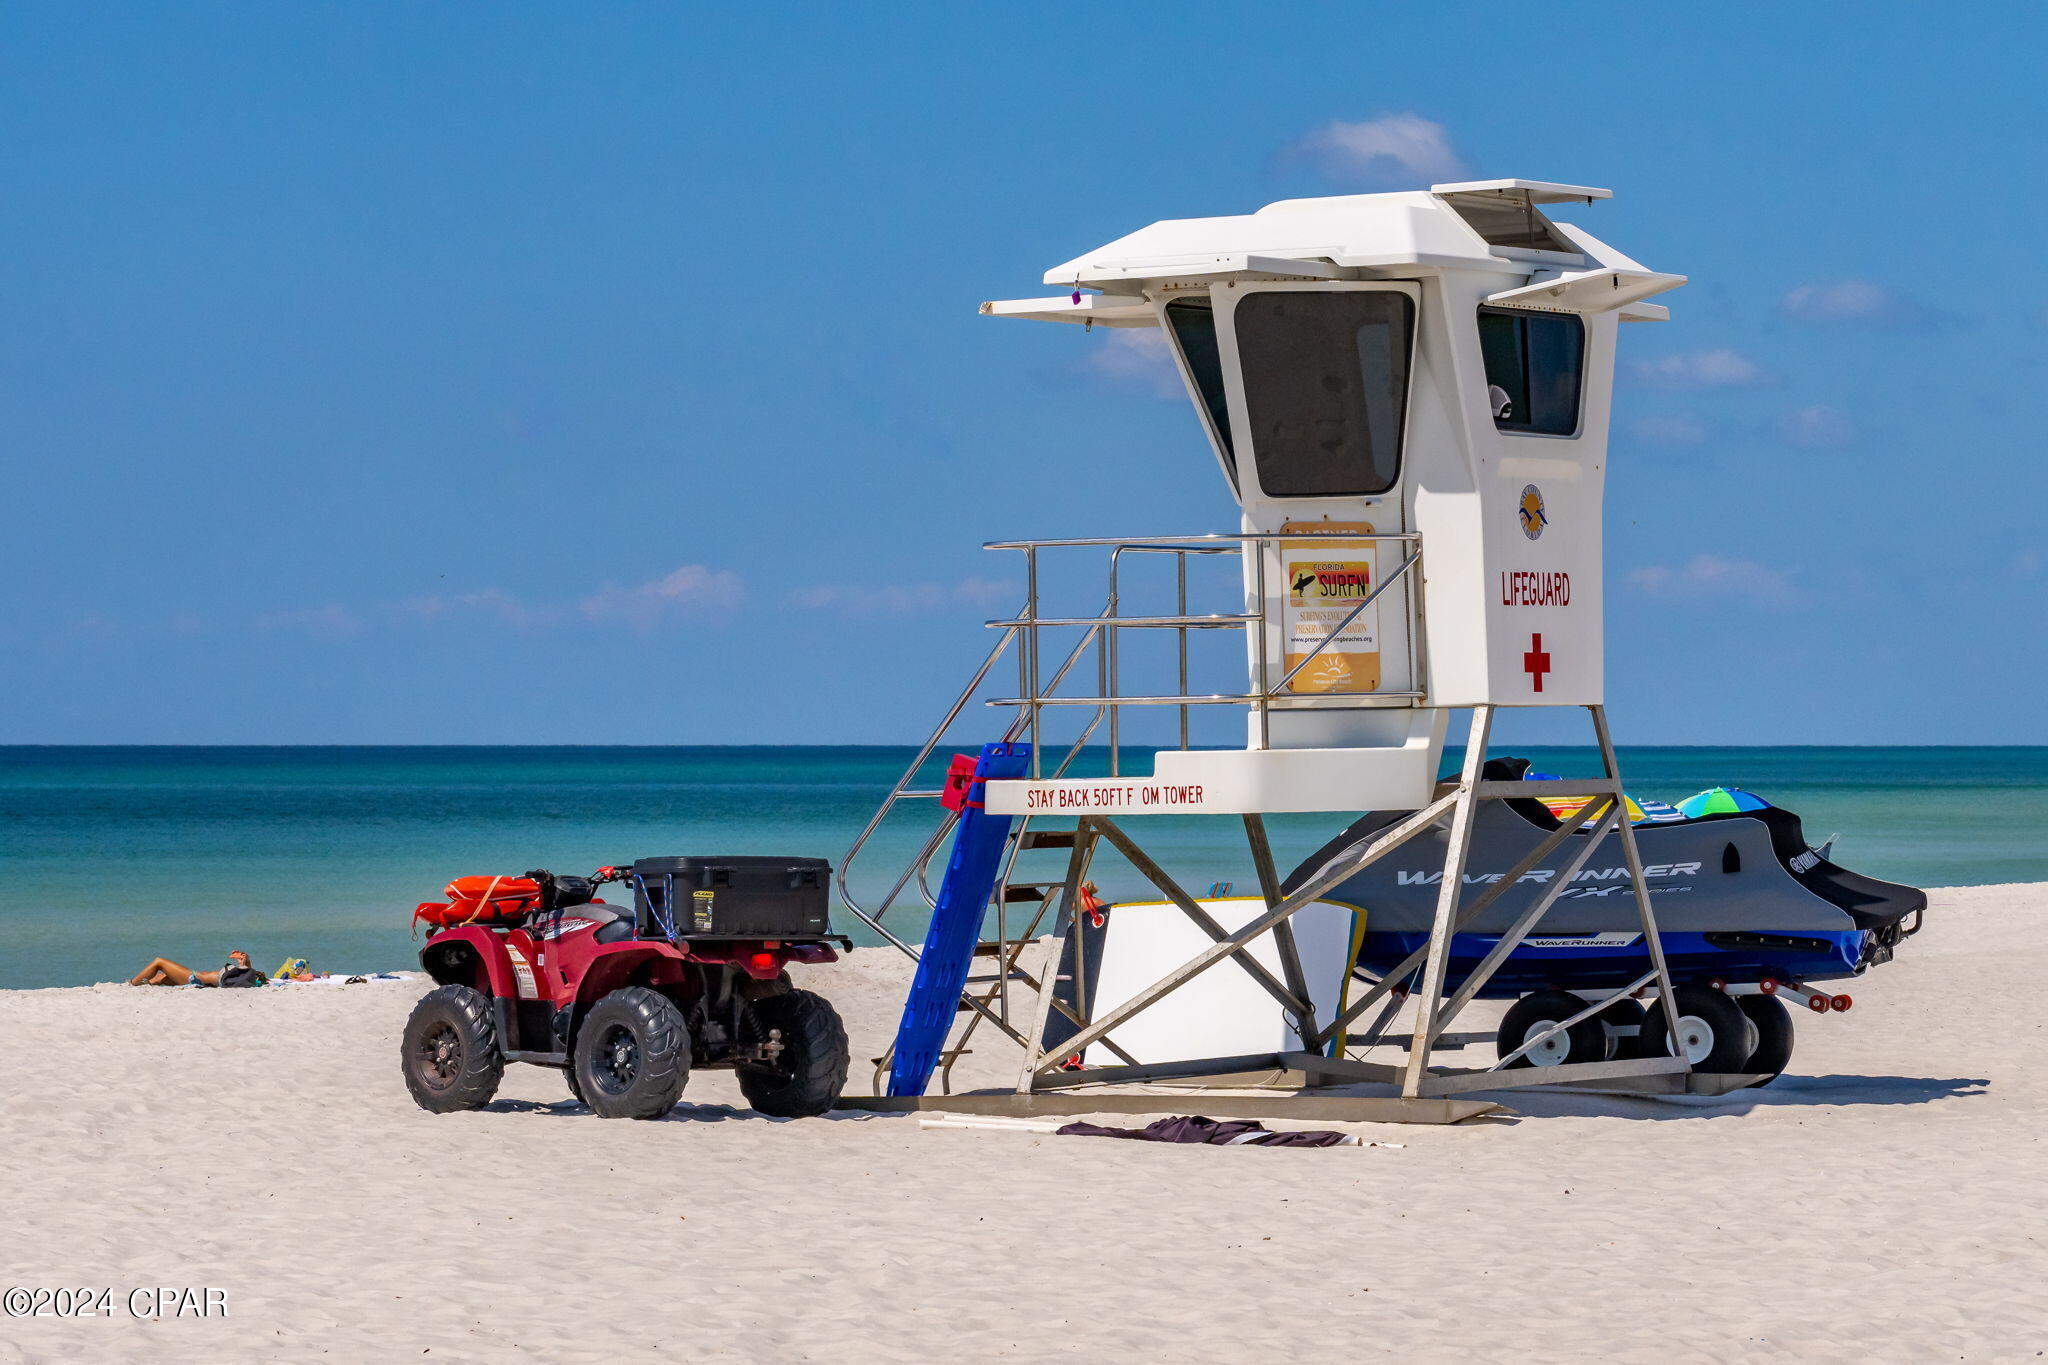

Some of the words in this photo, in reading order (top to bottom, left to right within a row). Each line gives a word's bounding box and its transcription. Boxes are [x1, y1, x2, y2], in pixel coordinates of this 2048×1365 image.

[1313, 563, 1345, 571] FLORIDA
[1320, 574, 1366, 597] SURFN
[1501, 571, 1571, 607] LIFEGUARD
[1027, 789, 1055, 808] STAY
[1058, 788, 1090, 808] BACK
[1093, 788, 1123, 807] 50FT
[1164, 785, 1204, 804] TOWER
